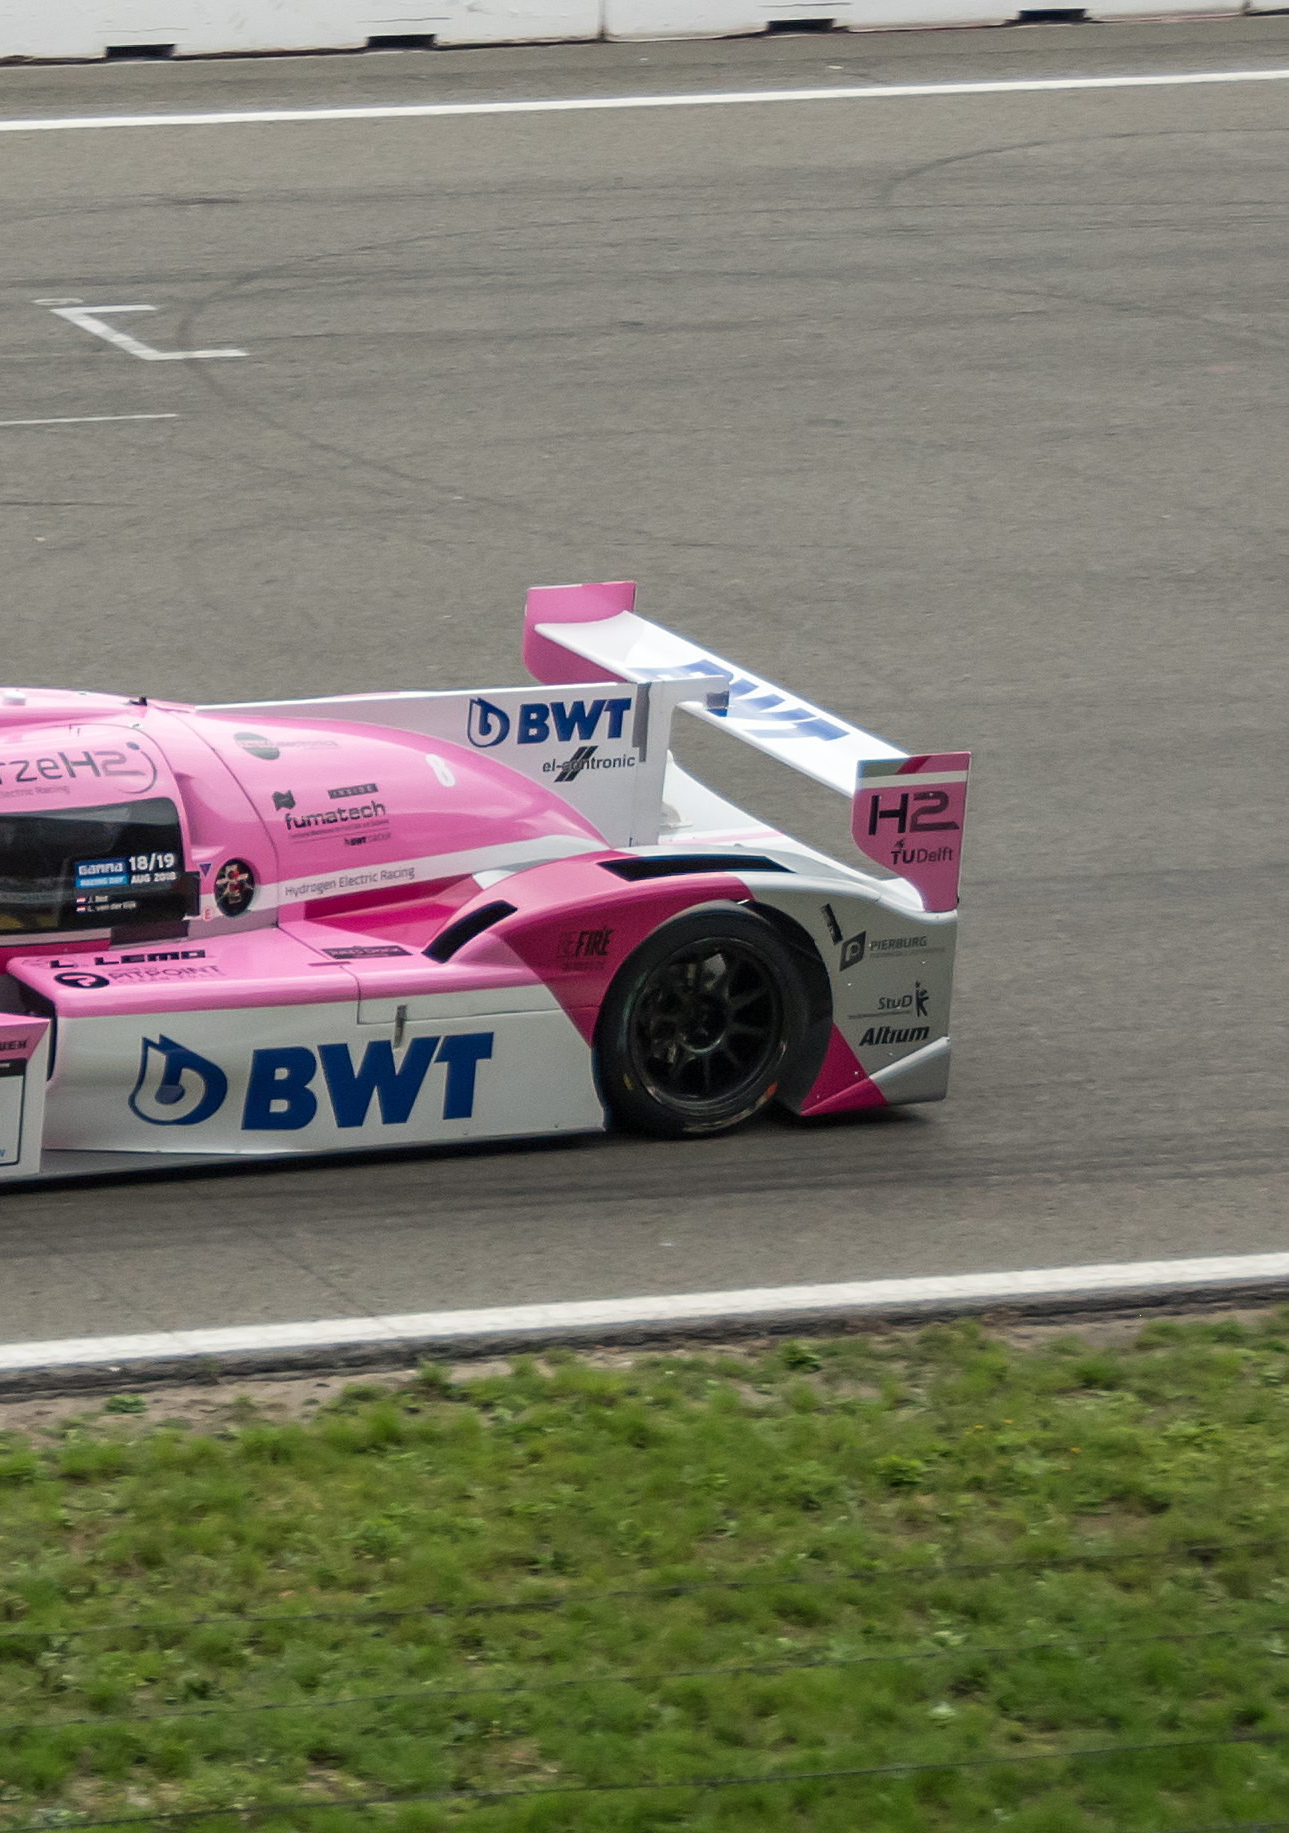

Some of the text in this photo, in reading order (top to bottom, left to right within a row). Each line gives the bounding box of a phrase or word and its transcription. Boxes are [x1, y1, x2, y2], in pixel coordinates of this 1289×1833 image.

[517, 698, 632, 746] BWT
[35, 785, 70, 795] Racing
[285, 800, 386, 830] fumatech
[868, 790, 960, 836] H2
[128, 852, 175, 872] 18/19
[285, 866, 415, 898] Hydrogen Electric Racing
[871, 936, 927, 951] PIERBURG
[858, 1026, 930, 1047] Altium
[241, 1031, 495, 1131] BWT
